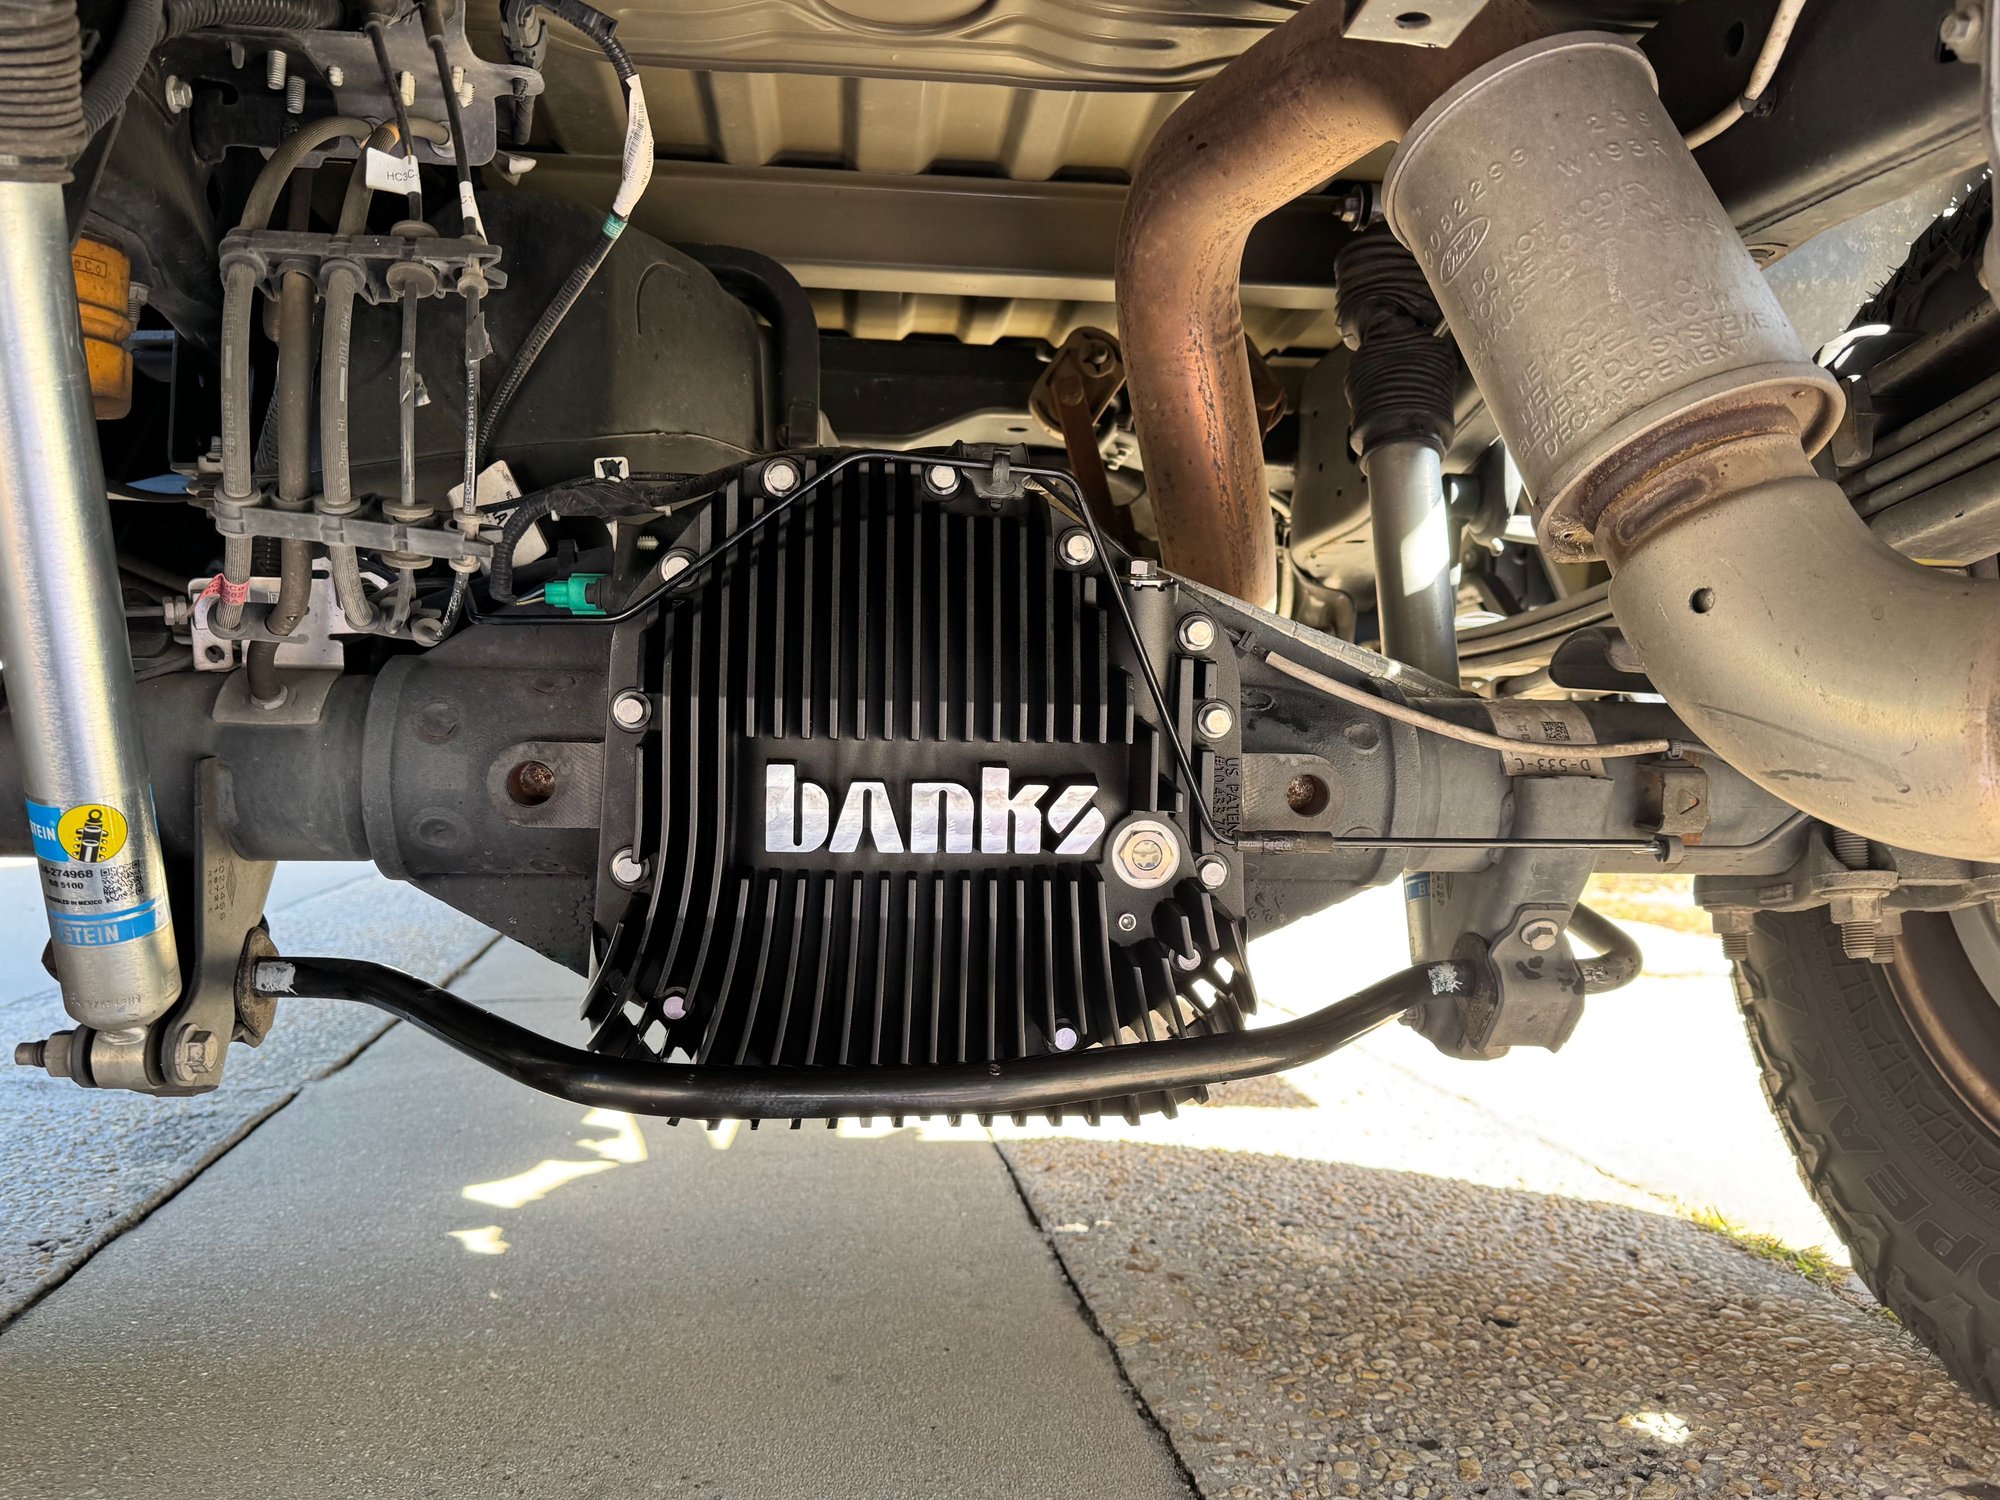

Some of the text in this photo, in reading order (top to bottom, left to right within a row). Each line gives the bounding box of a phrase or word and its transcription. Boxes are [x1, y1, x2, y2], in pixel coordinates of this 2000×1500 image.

[1472, 264, 1498, 300] DO
[1500, 219, 1546, 269] NOT
[1601, 346, 1645, 382] DU
[765, 764, 1106, 855] banks
[1225, 757, 1240, 838] US PATEN
[60, 881, 84, 890] 5100
